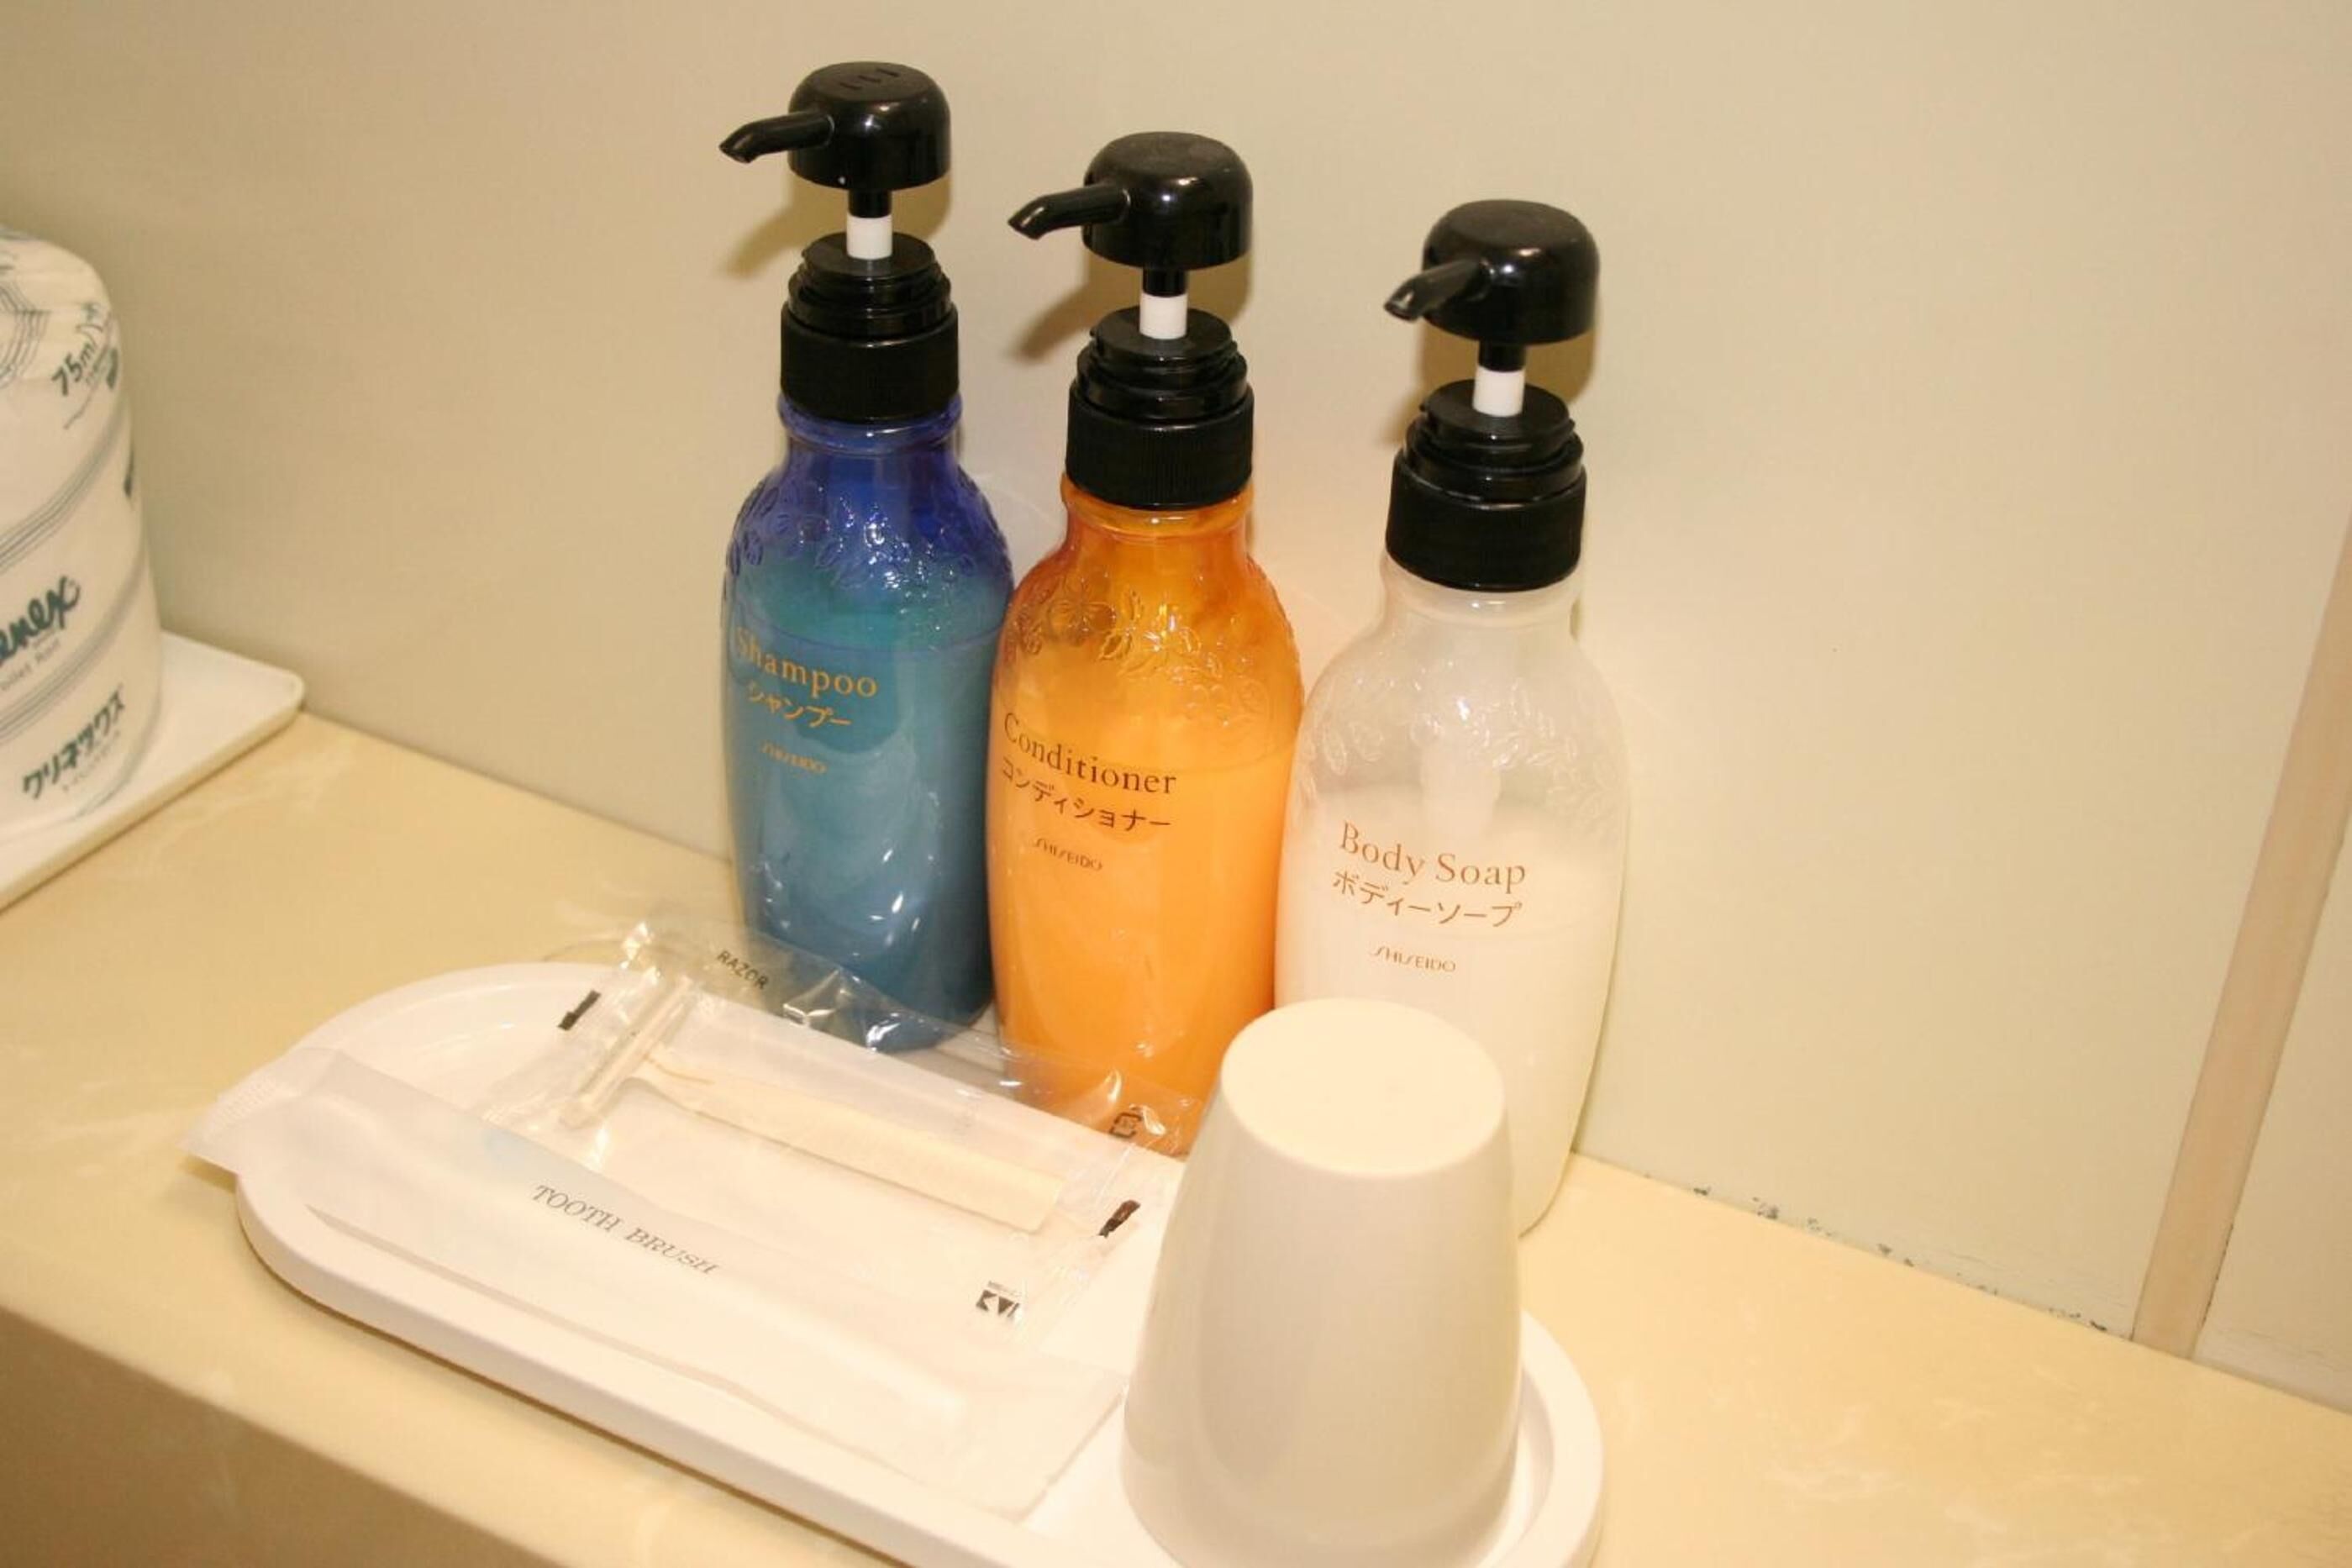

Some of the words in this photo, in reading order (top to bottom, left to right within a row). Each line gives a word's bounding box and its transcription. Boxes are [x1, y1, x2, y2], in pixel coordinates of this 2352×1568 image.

[737, 626, 878, 699] Shampoo
[748, 681, 852, 729] シャンプー
[1003, 712, 1177, 795] Conditioner
[1002, 755, 1172, 832] コンディショナー
[1034, 837, 1103, 871] SHISEIDO
[1339, 820, 1426, 886] Body
[1434, 852, 1526, 896] Soap
[1332, 870, 1523, 928] ボディーソープ
[716, 950, 770, 991] RAZOR
[1373, 944, 1457, 973] SHISEIDO
[532, 1183, 623, 1233] TOOTH
[624, 1226, 720, 1274] BRUSH
